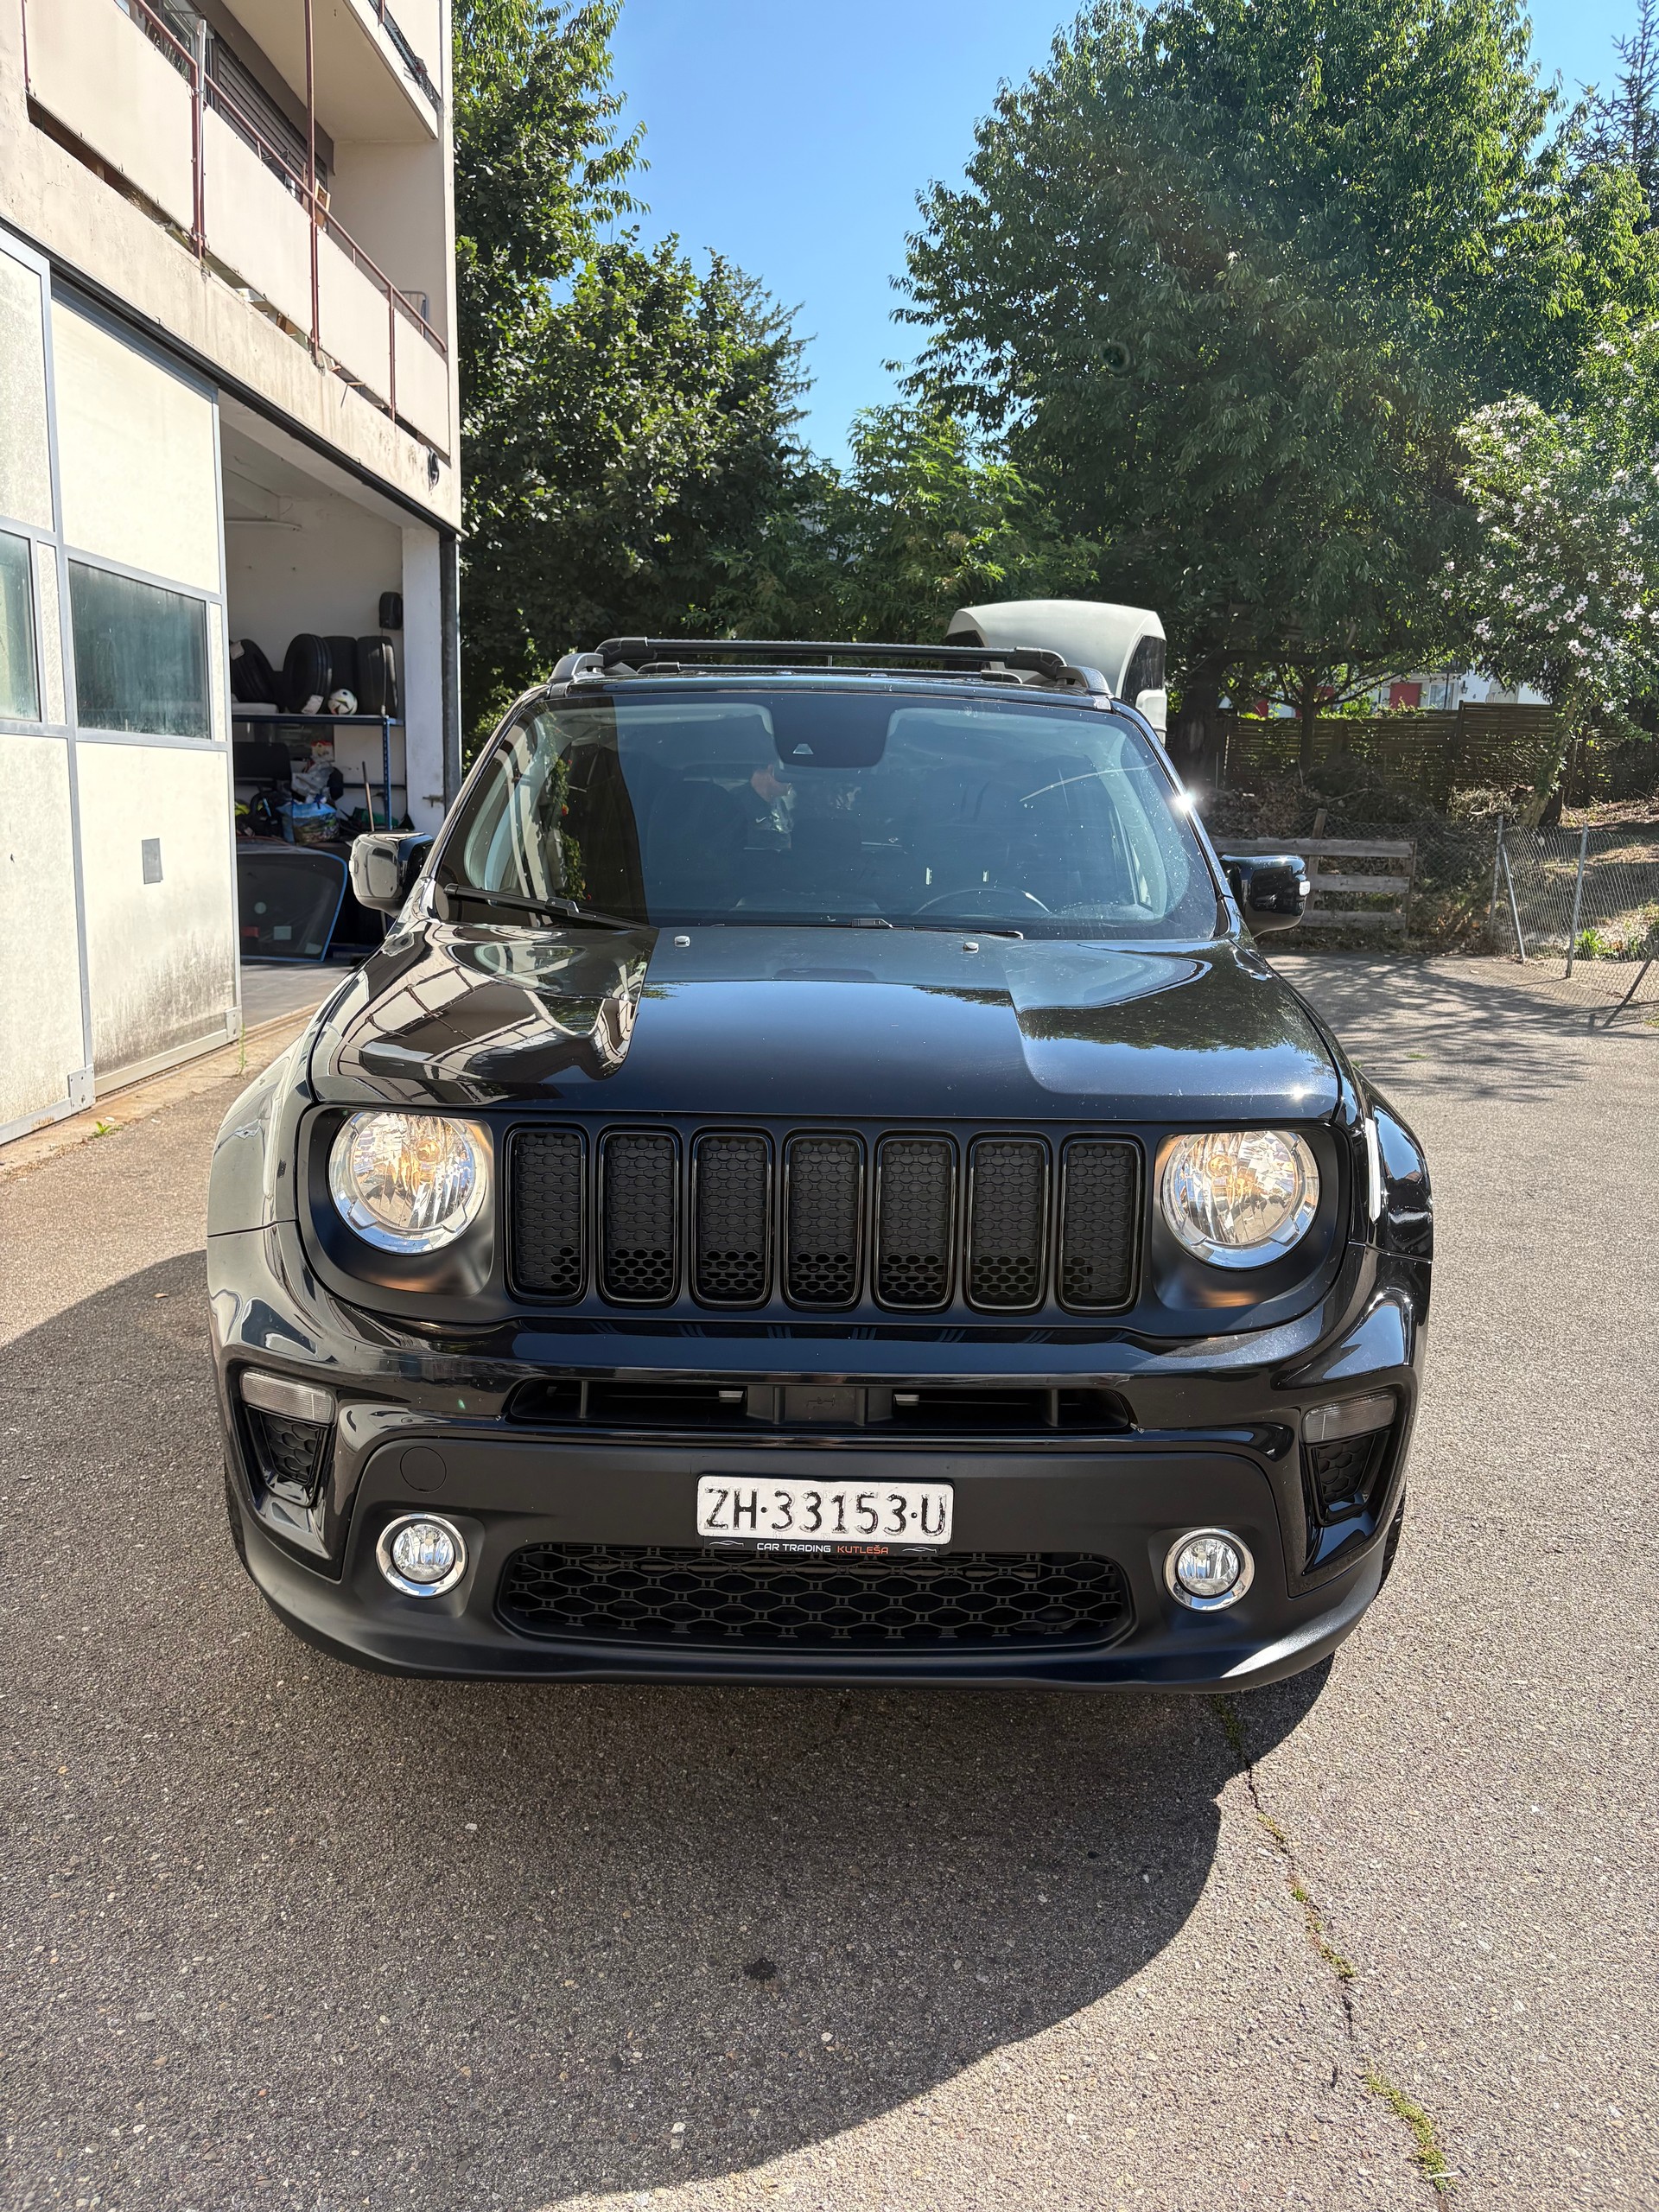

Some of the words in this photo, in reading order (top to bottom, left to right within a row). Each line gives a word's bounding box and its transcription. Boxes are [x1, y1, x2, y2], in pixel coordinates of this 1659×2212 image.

[757, 1542, 779, 1551] CAR
[782, 1543, 831, 1553] TRADING
[837, 1545, 888, 1554] KUTLEŠA
